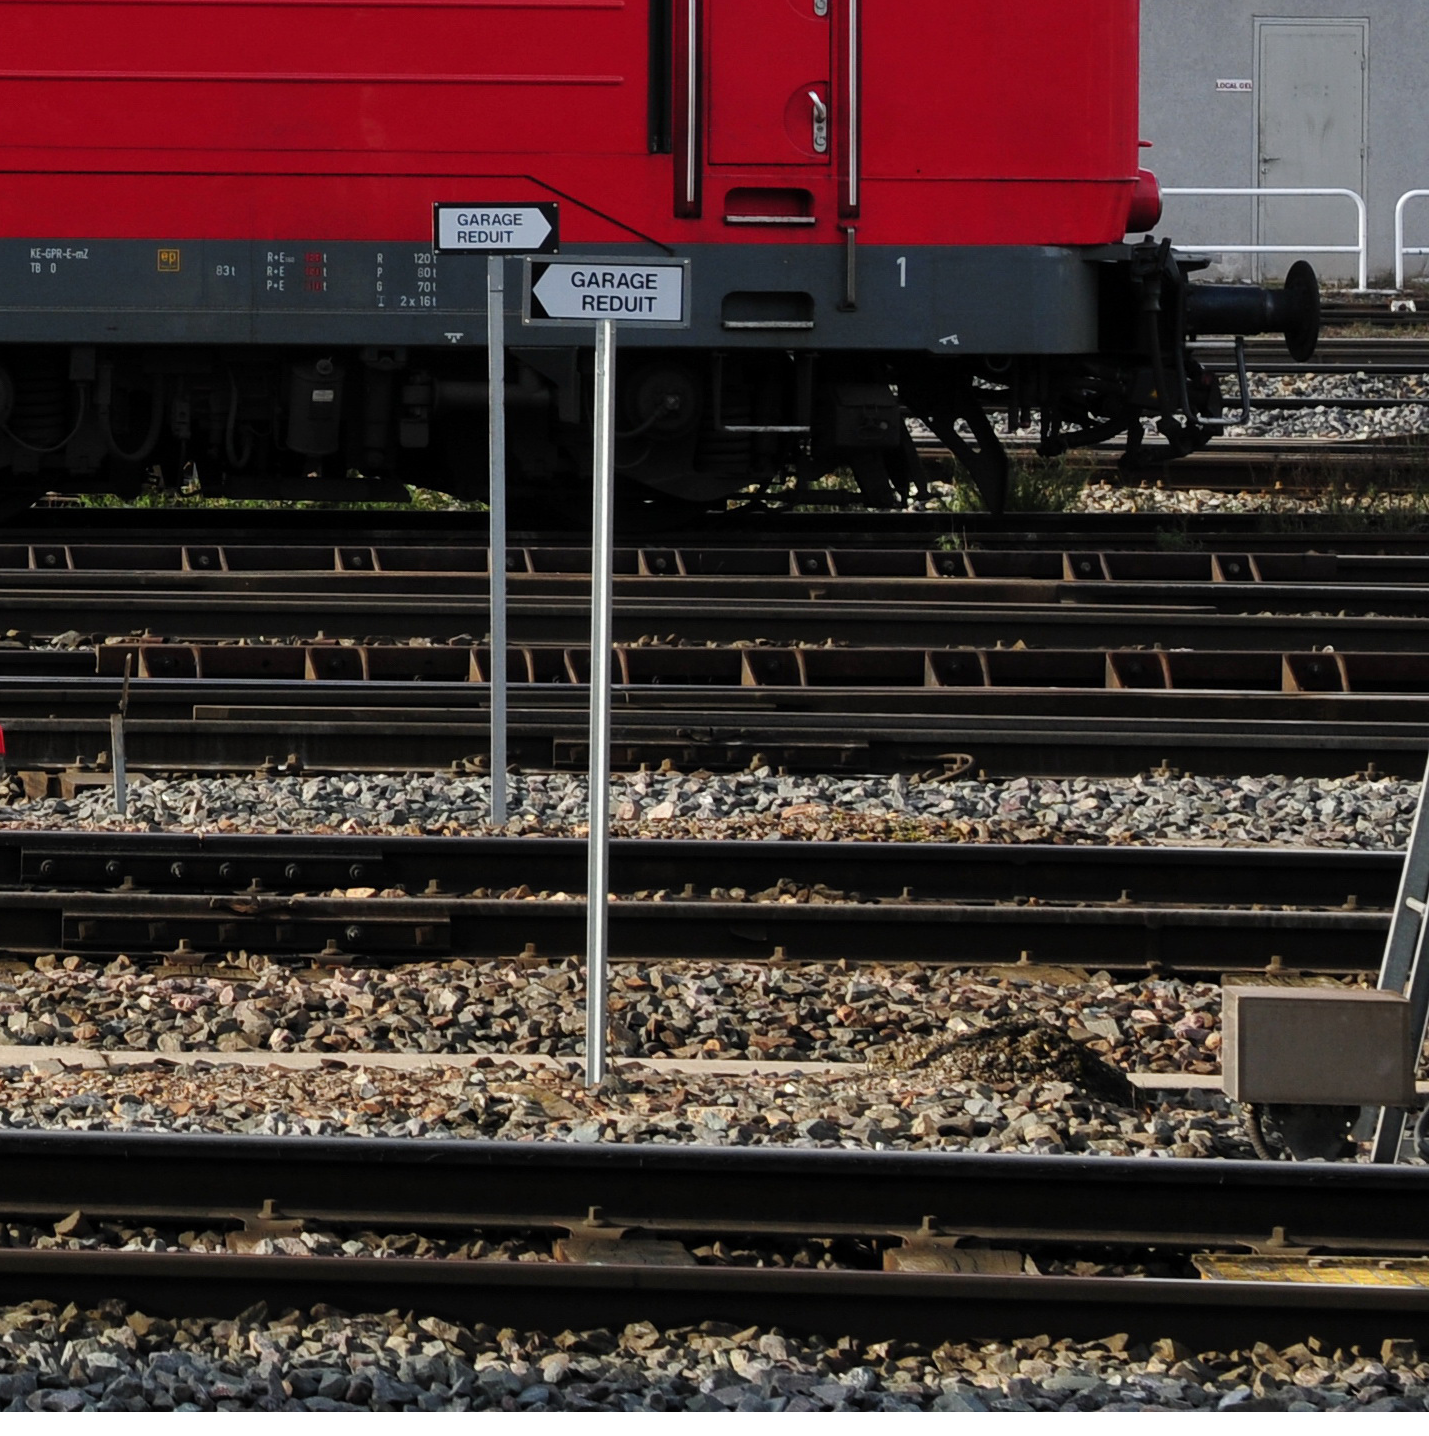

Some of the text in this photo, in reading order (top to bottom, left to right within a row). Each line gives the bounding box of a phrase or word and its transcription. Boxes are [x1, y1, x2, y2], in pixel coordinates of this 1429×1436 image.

[457, 214, 523, 226] GARAGE
[457, 230, 514, 244] REDUIT
[30, 248, 89, 259] KE-GPR-E-mZ
[160, 252, 176, 265] ep
[376, 253, 383, 264] R
[30, 262, 41, 274] TB
[376, 267, 383, 278] P
[896, 256, 906, 288] 1
[376, 281, 382, 292] G
[571, 272, 658, 290] GARAGE
[400, 296, 407, 306] 2
[582, 294, 658, 312] REDUIT
